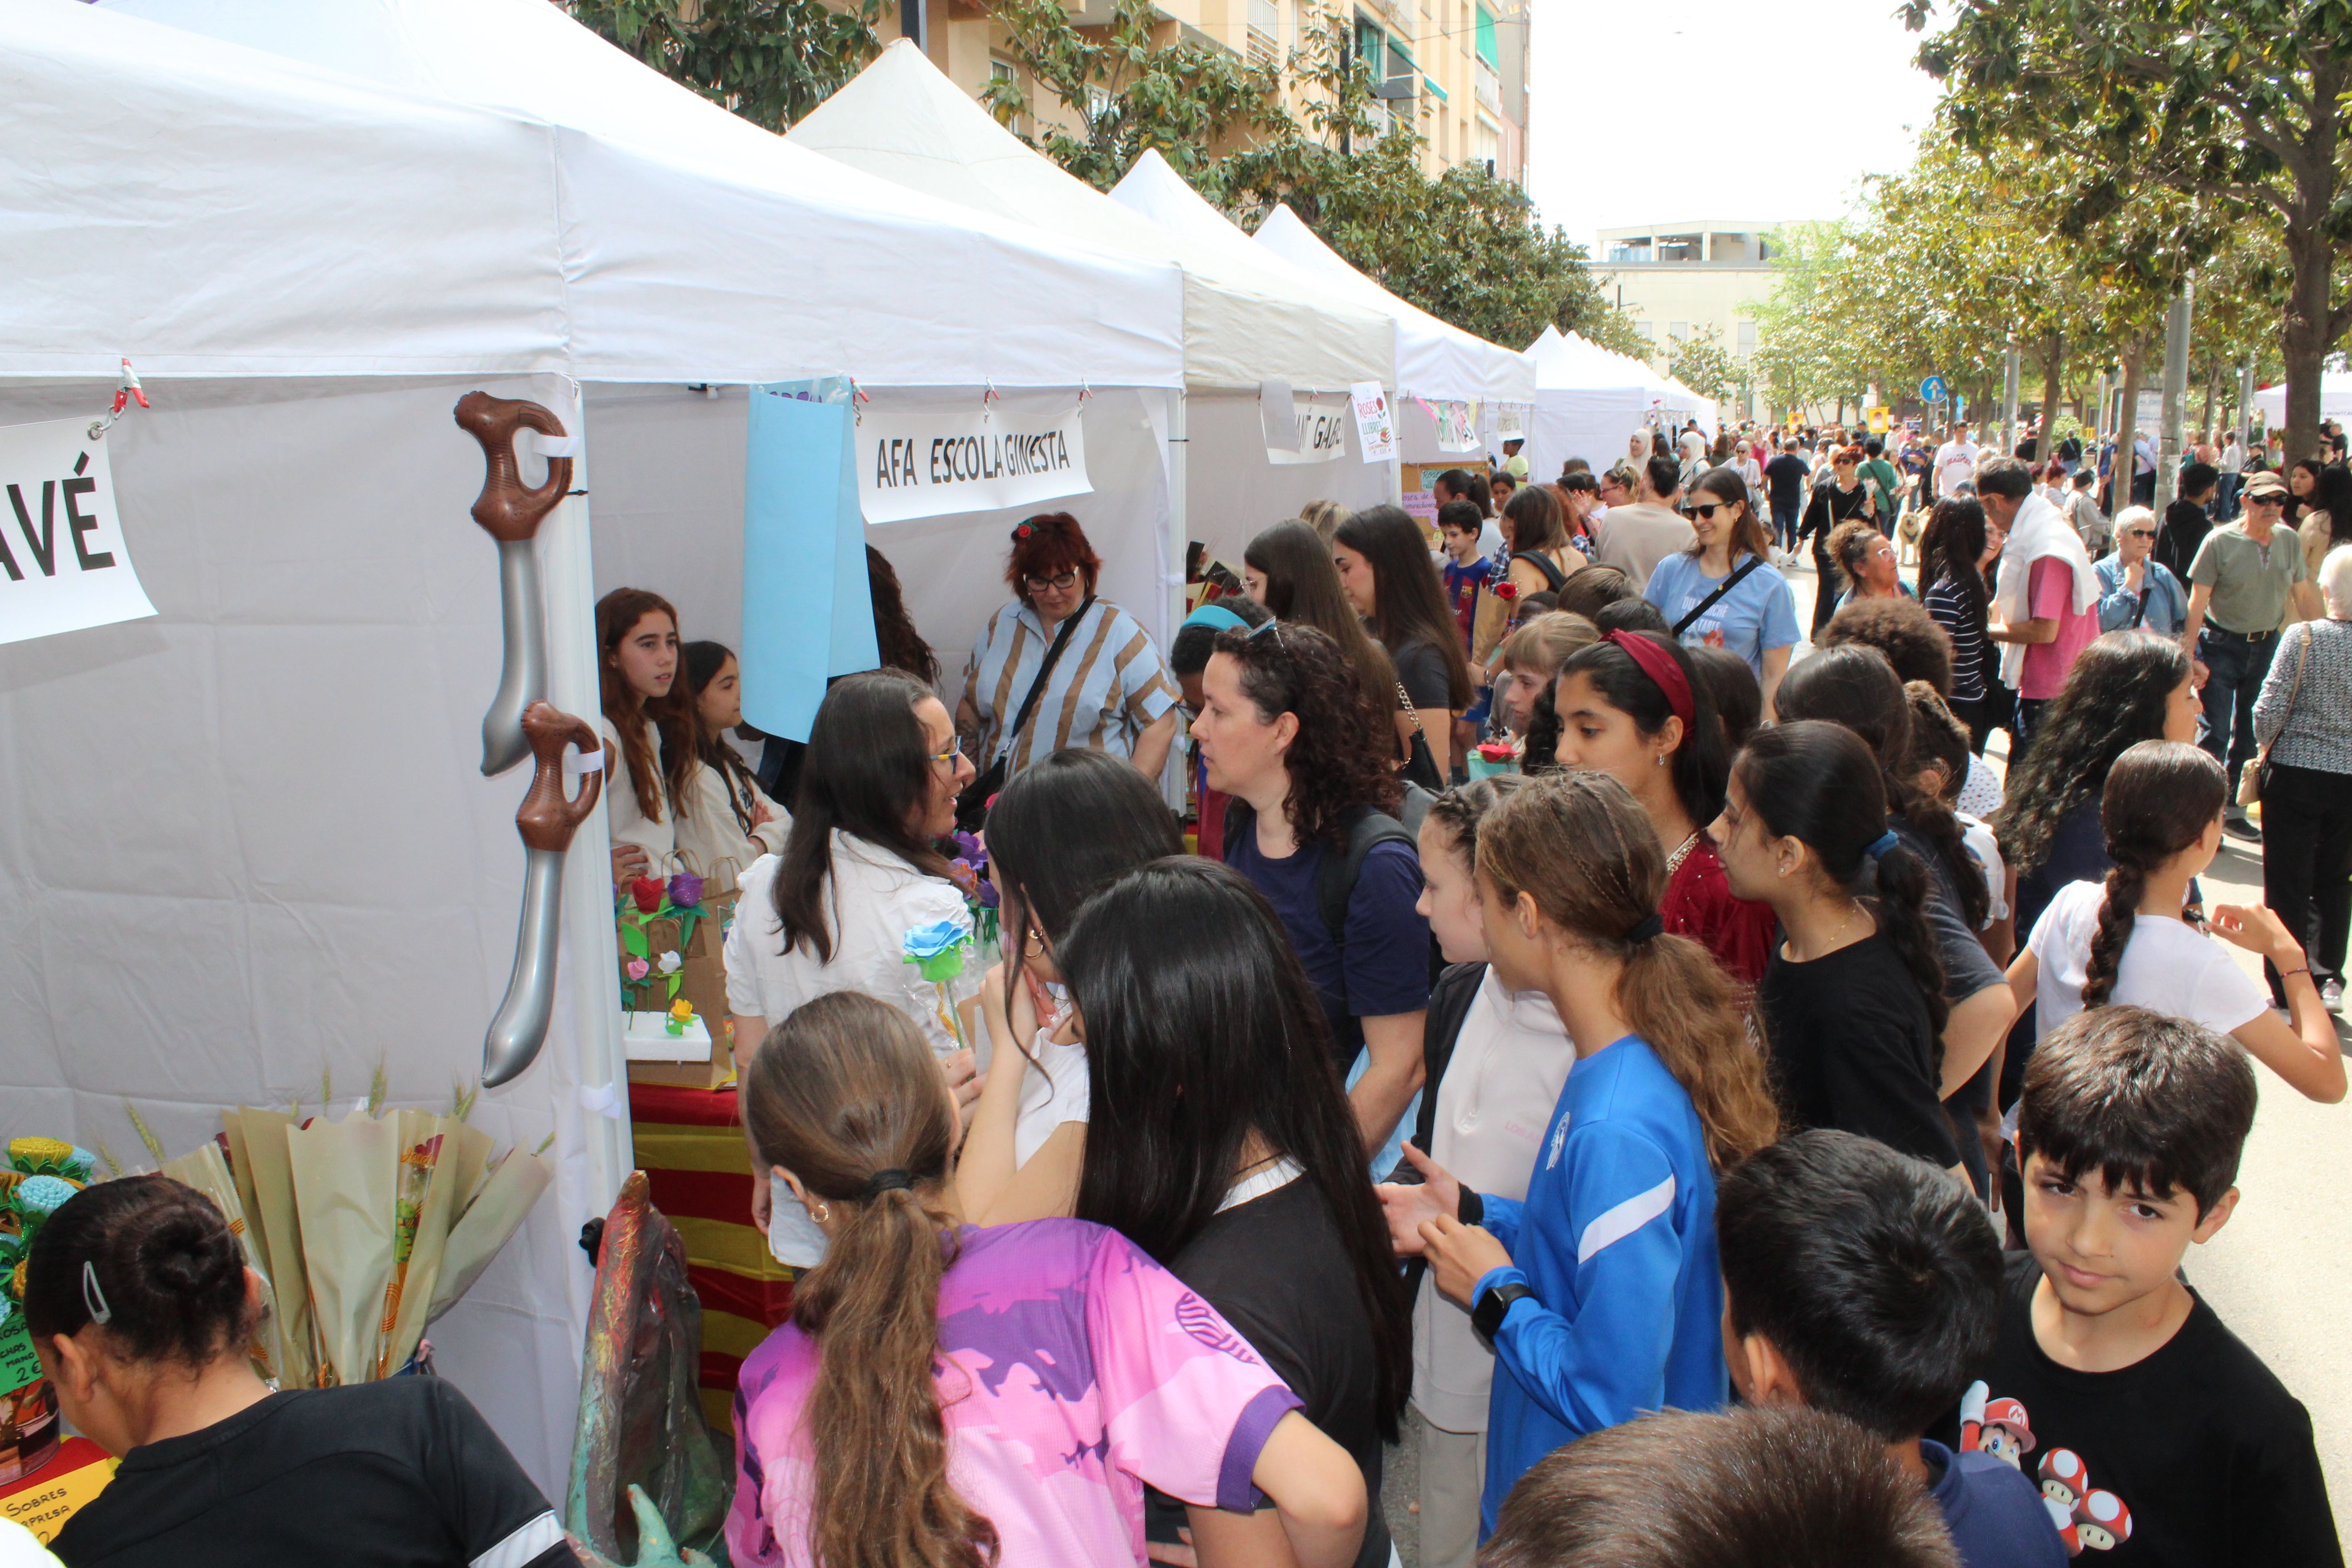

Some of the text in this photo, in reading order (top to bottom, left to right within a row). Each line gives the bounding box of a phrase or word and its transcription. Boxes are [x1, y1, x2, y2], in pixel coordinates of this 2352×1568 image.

[1357, 401, 1377, 418] ROSES
[1362, 421, 1382, 436] LLIBRES
[877, 429, 1071, 489] AFA ESCOLA GINESTA
[0, 1342, 26, 1358] CHAS
[6, 1488, 68, 1517] SOBRES
[21, 1505, 71, 1528] RPRESA
